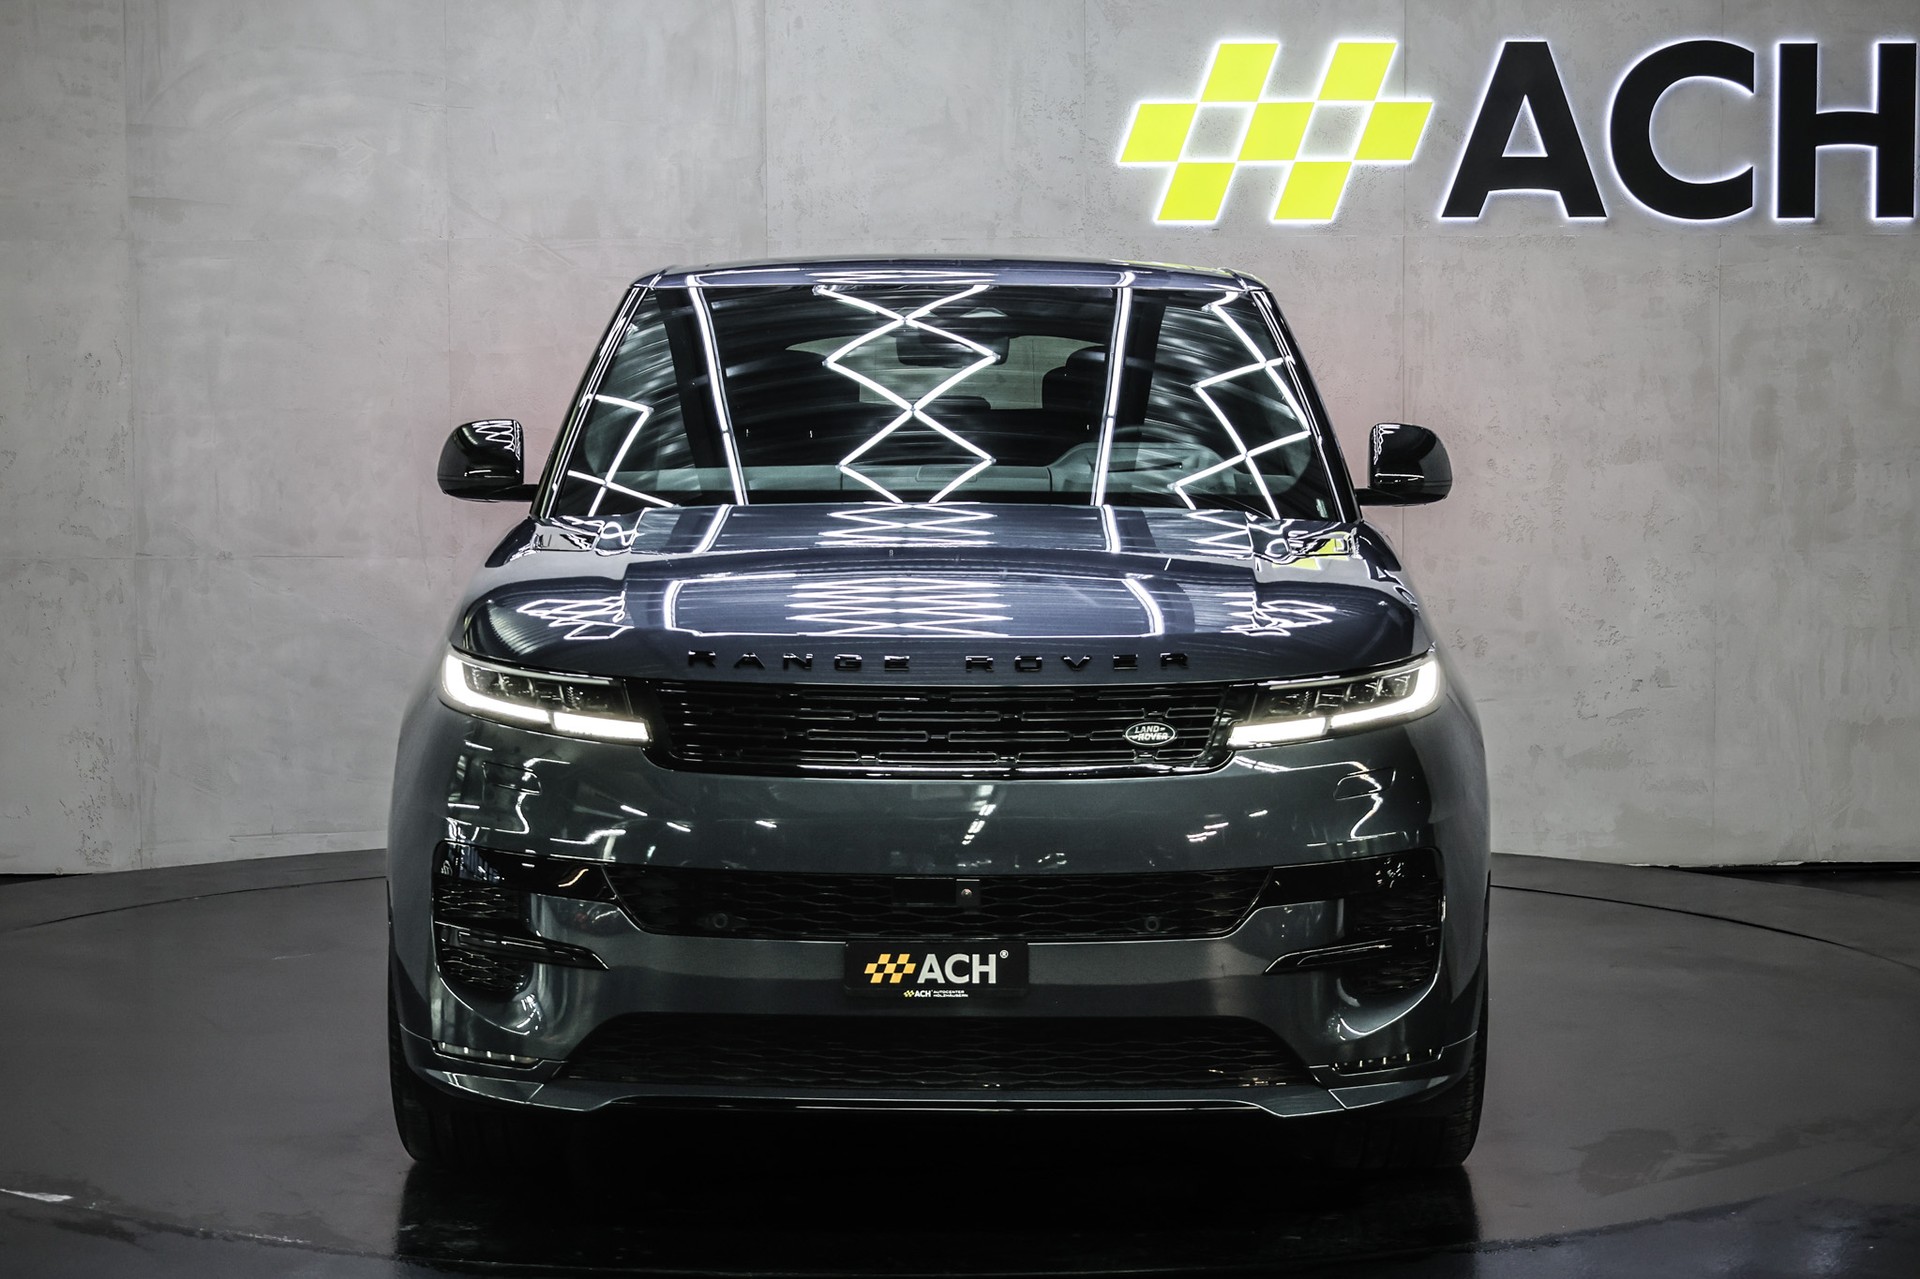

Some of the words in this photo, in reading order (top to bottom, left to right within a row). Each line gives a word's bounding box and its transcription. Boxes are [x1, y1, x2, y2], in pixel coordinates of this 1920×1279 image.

[1442, 40, 1917, 220] ACH
[687, 649, 911, 672] RANGE
[964, 652, 1190, 672] ROVER
